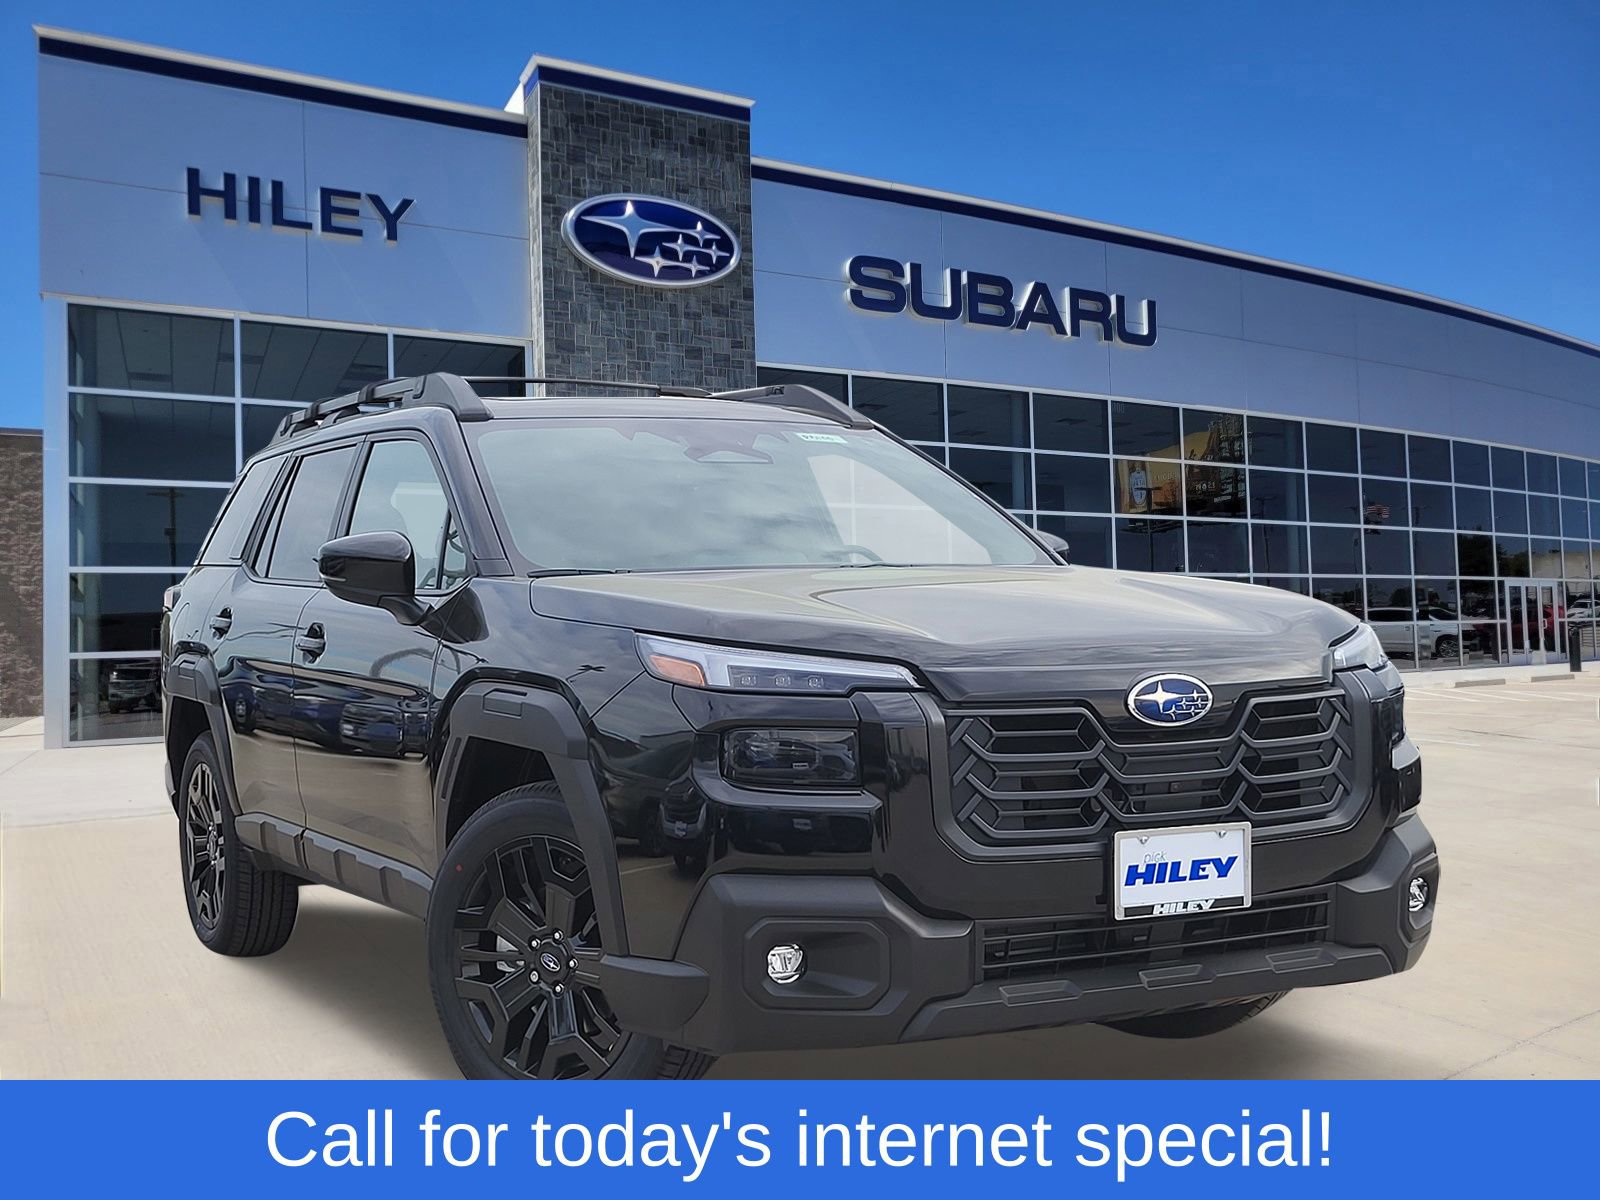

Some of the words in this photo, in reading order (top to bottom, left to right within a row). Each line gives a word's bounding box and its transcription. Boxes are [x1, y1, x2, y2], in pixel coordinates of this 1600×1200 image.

[186, 167, 415, 242] HILEY
[847, 255, 1158, 347] SUBARU
[1124, 855, 1239, 887] HILEY
[1153, 898, 1215, 916] HILEY
